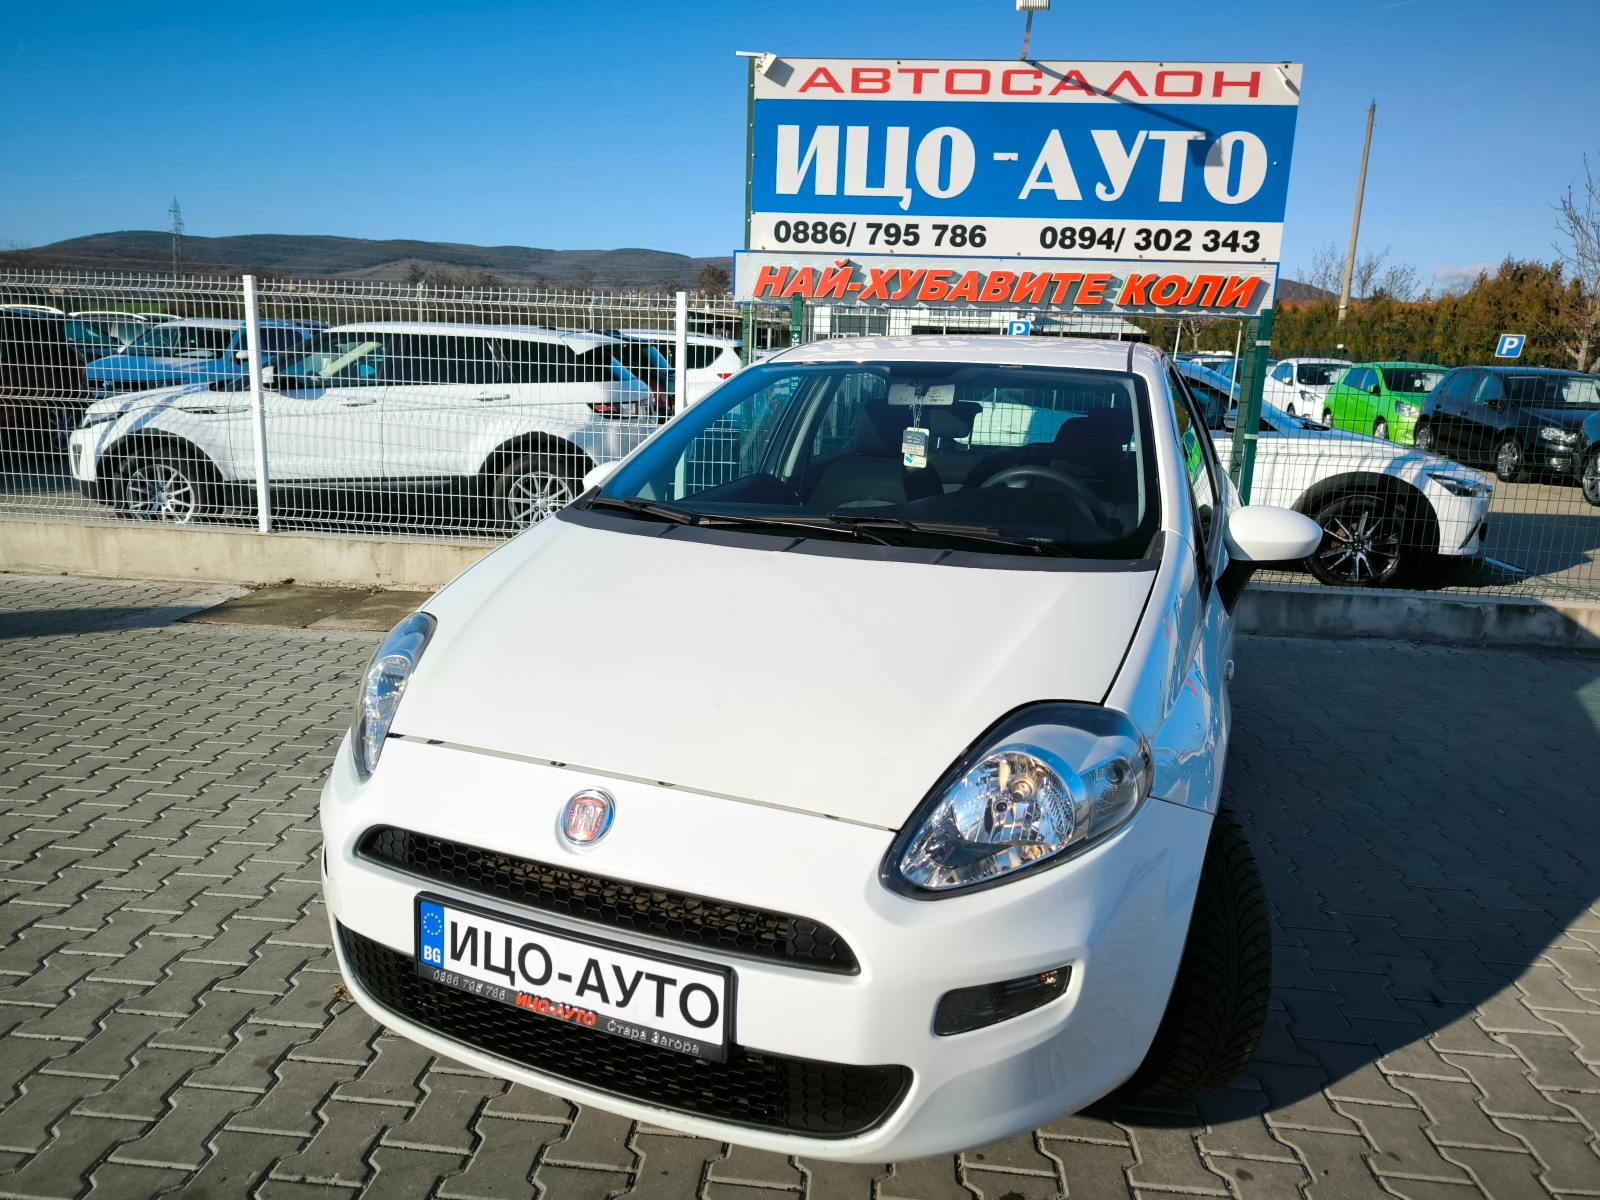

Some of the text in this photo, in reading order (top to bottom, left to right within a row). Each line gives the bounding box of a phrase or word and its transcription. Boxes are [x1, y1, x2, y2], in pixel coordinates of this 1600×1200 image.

[798, 66, 1262, 98] АВТОСАЛОН
[774, 220, 987, 248] 0886/ 795 786
[1039, 226, 1260, 253] 0894/ 302 343
[752, 259, 1261, 309] НАЙ-ХУБАВИТЕ КОЛИ
[1012, 322, 1026, 336] P
[1501, 337, 1519, 355] P
[423, 944, 441, 964] BG
[433, 970, 506, 1001] 0886 795 786
[450, 920, 720, 1029] ИЦО-АУТО
[515, 991, 597, 1027] ИЦО-АУТО
[607, 1020, 647, 1041] Стара
